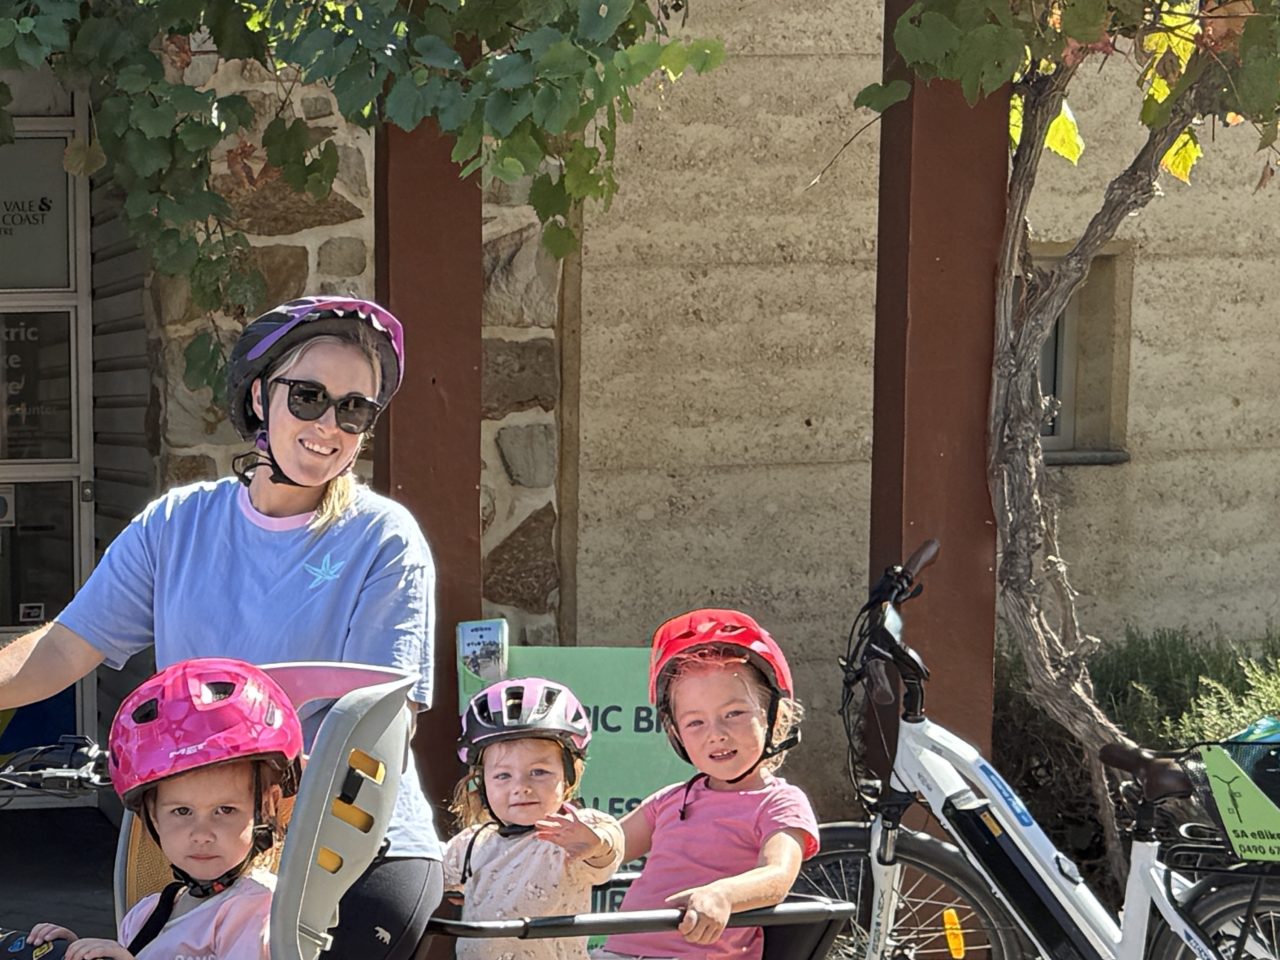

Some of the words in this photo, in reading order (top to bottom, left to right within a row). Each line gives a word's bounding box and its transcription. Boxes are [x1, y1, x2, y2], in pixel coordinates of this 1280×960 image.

[3, 200, 35, 212] VALE
[38, 196, 52, 212] &
[2, 213, 46, 225] COAST
[1232, 829, 1249, 839] SA
